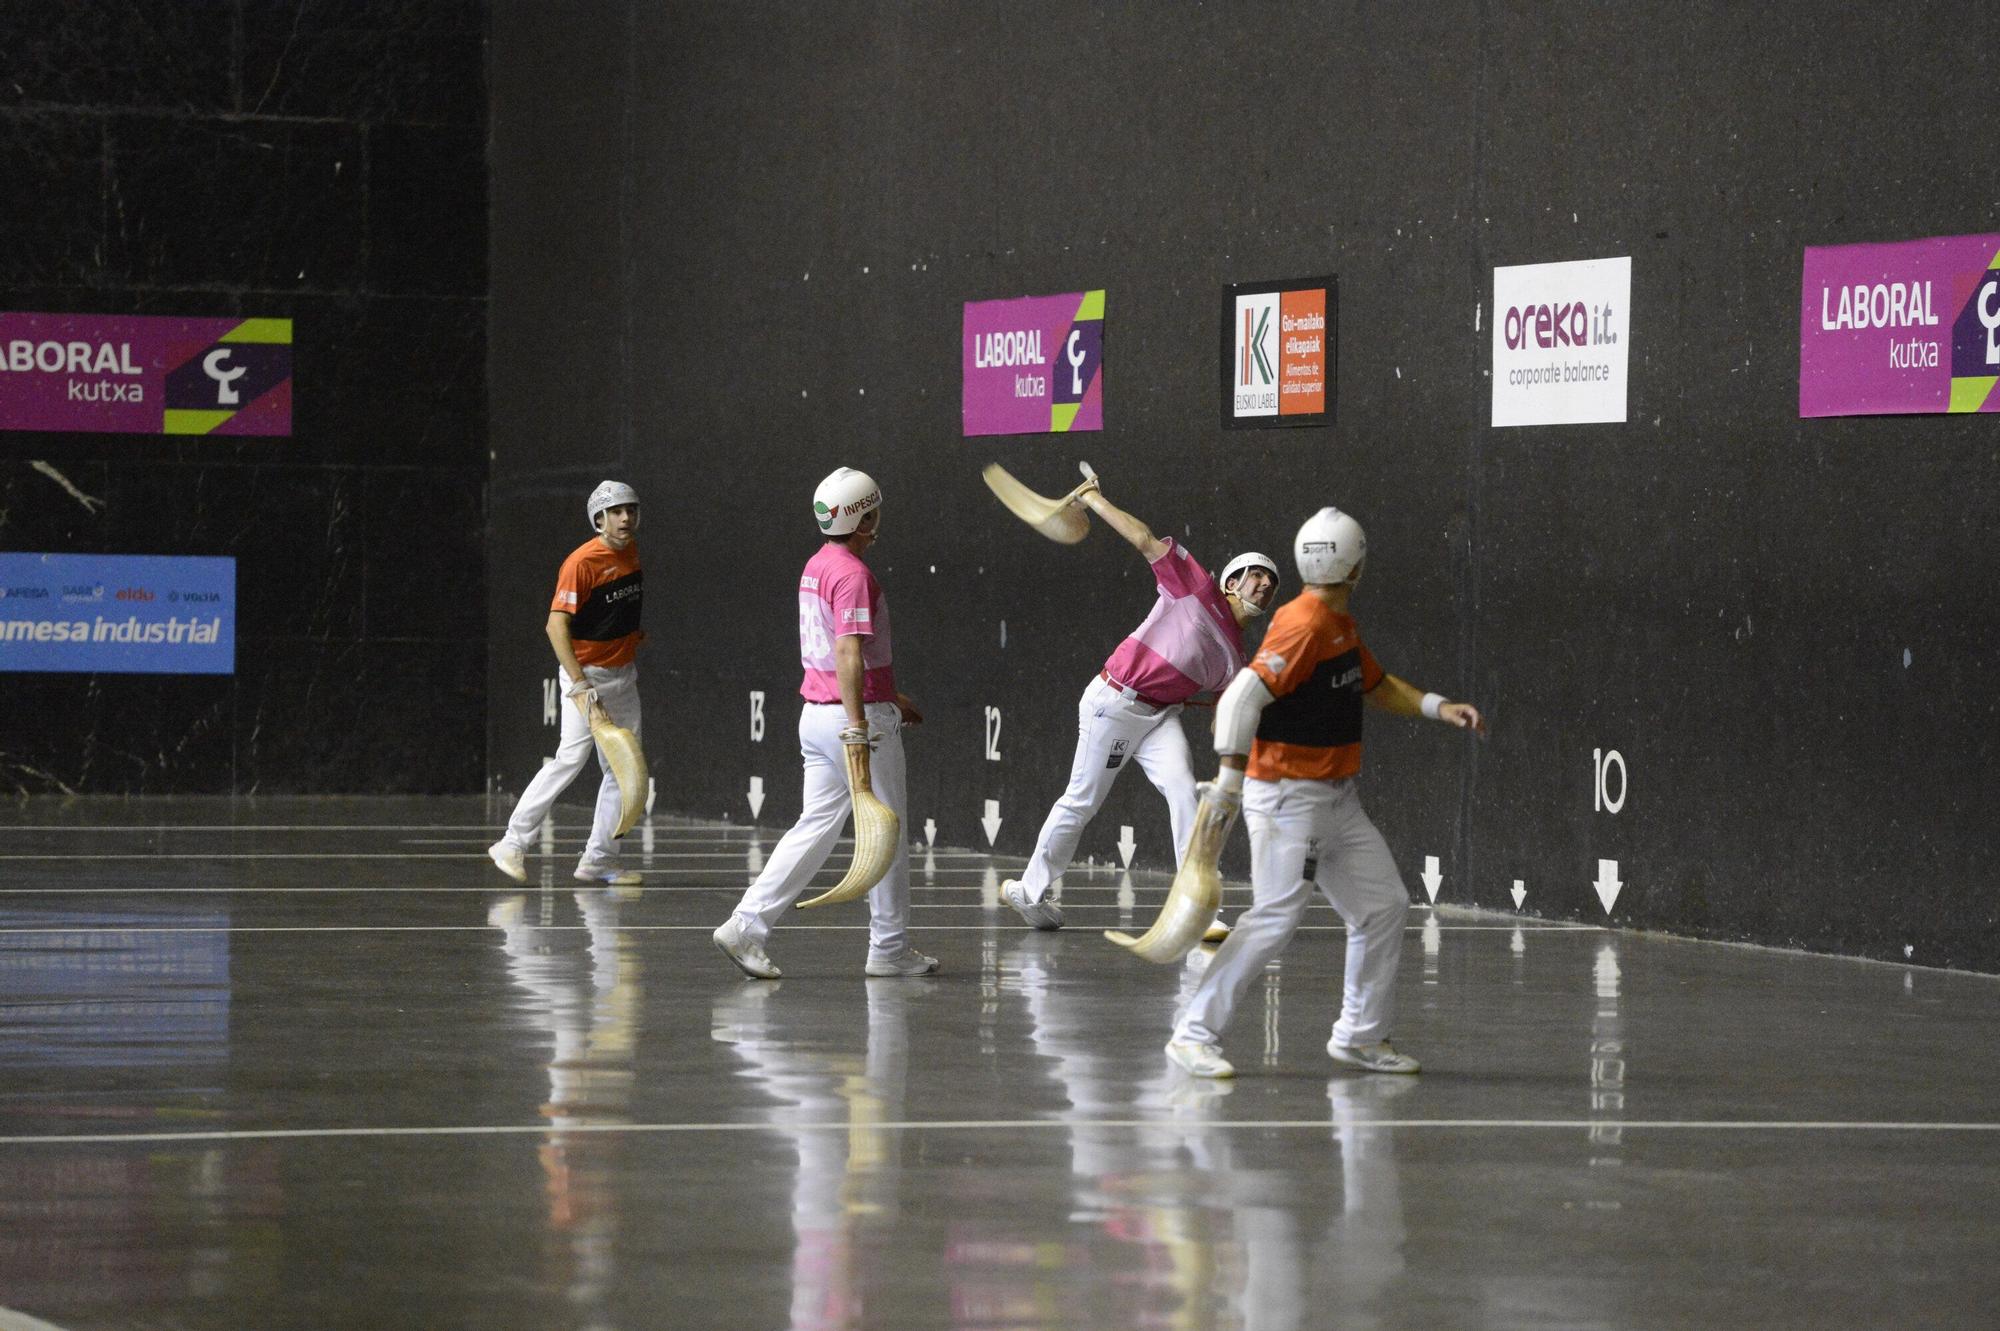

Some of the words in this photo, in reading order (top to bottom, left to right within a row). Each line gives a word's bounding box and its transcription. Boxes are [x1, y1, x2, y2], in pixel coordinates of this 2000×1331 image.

[1282, 313, 1324, 332] Goi-mailako
[1822, 281, 1938, 330] LABORAL
[1505, 301, 1588, 350] oreka
[1593, 301, 1617, 345] i.t.
[975, 330, 1046, 368] LABORAL
[1889, 337, 1939, 368] kutxa
[68, 379, 143, 402] kutxa
[1015, 373, 1045, 398] kutxa
[1509, 362, 1561, 389] corporate
[1564, 360, 1609, 383] balance
[1236, 394, 1256, 410] EUSKO
[1258, 393, 1277, 409] LABEL
[0, 619, 90, 641] mesa
[93, 615, 220, 643] industrial
[543, 678, 557, 726] 14
[750, 690, 765, 742] 13
[985, 705, 1001, 760] 12
[1593, 748, 1627, 814] 10
